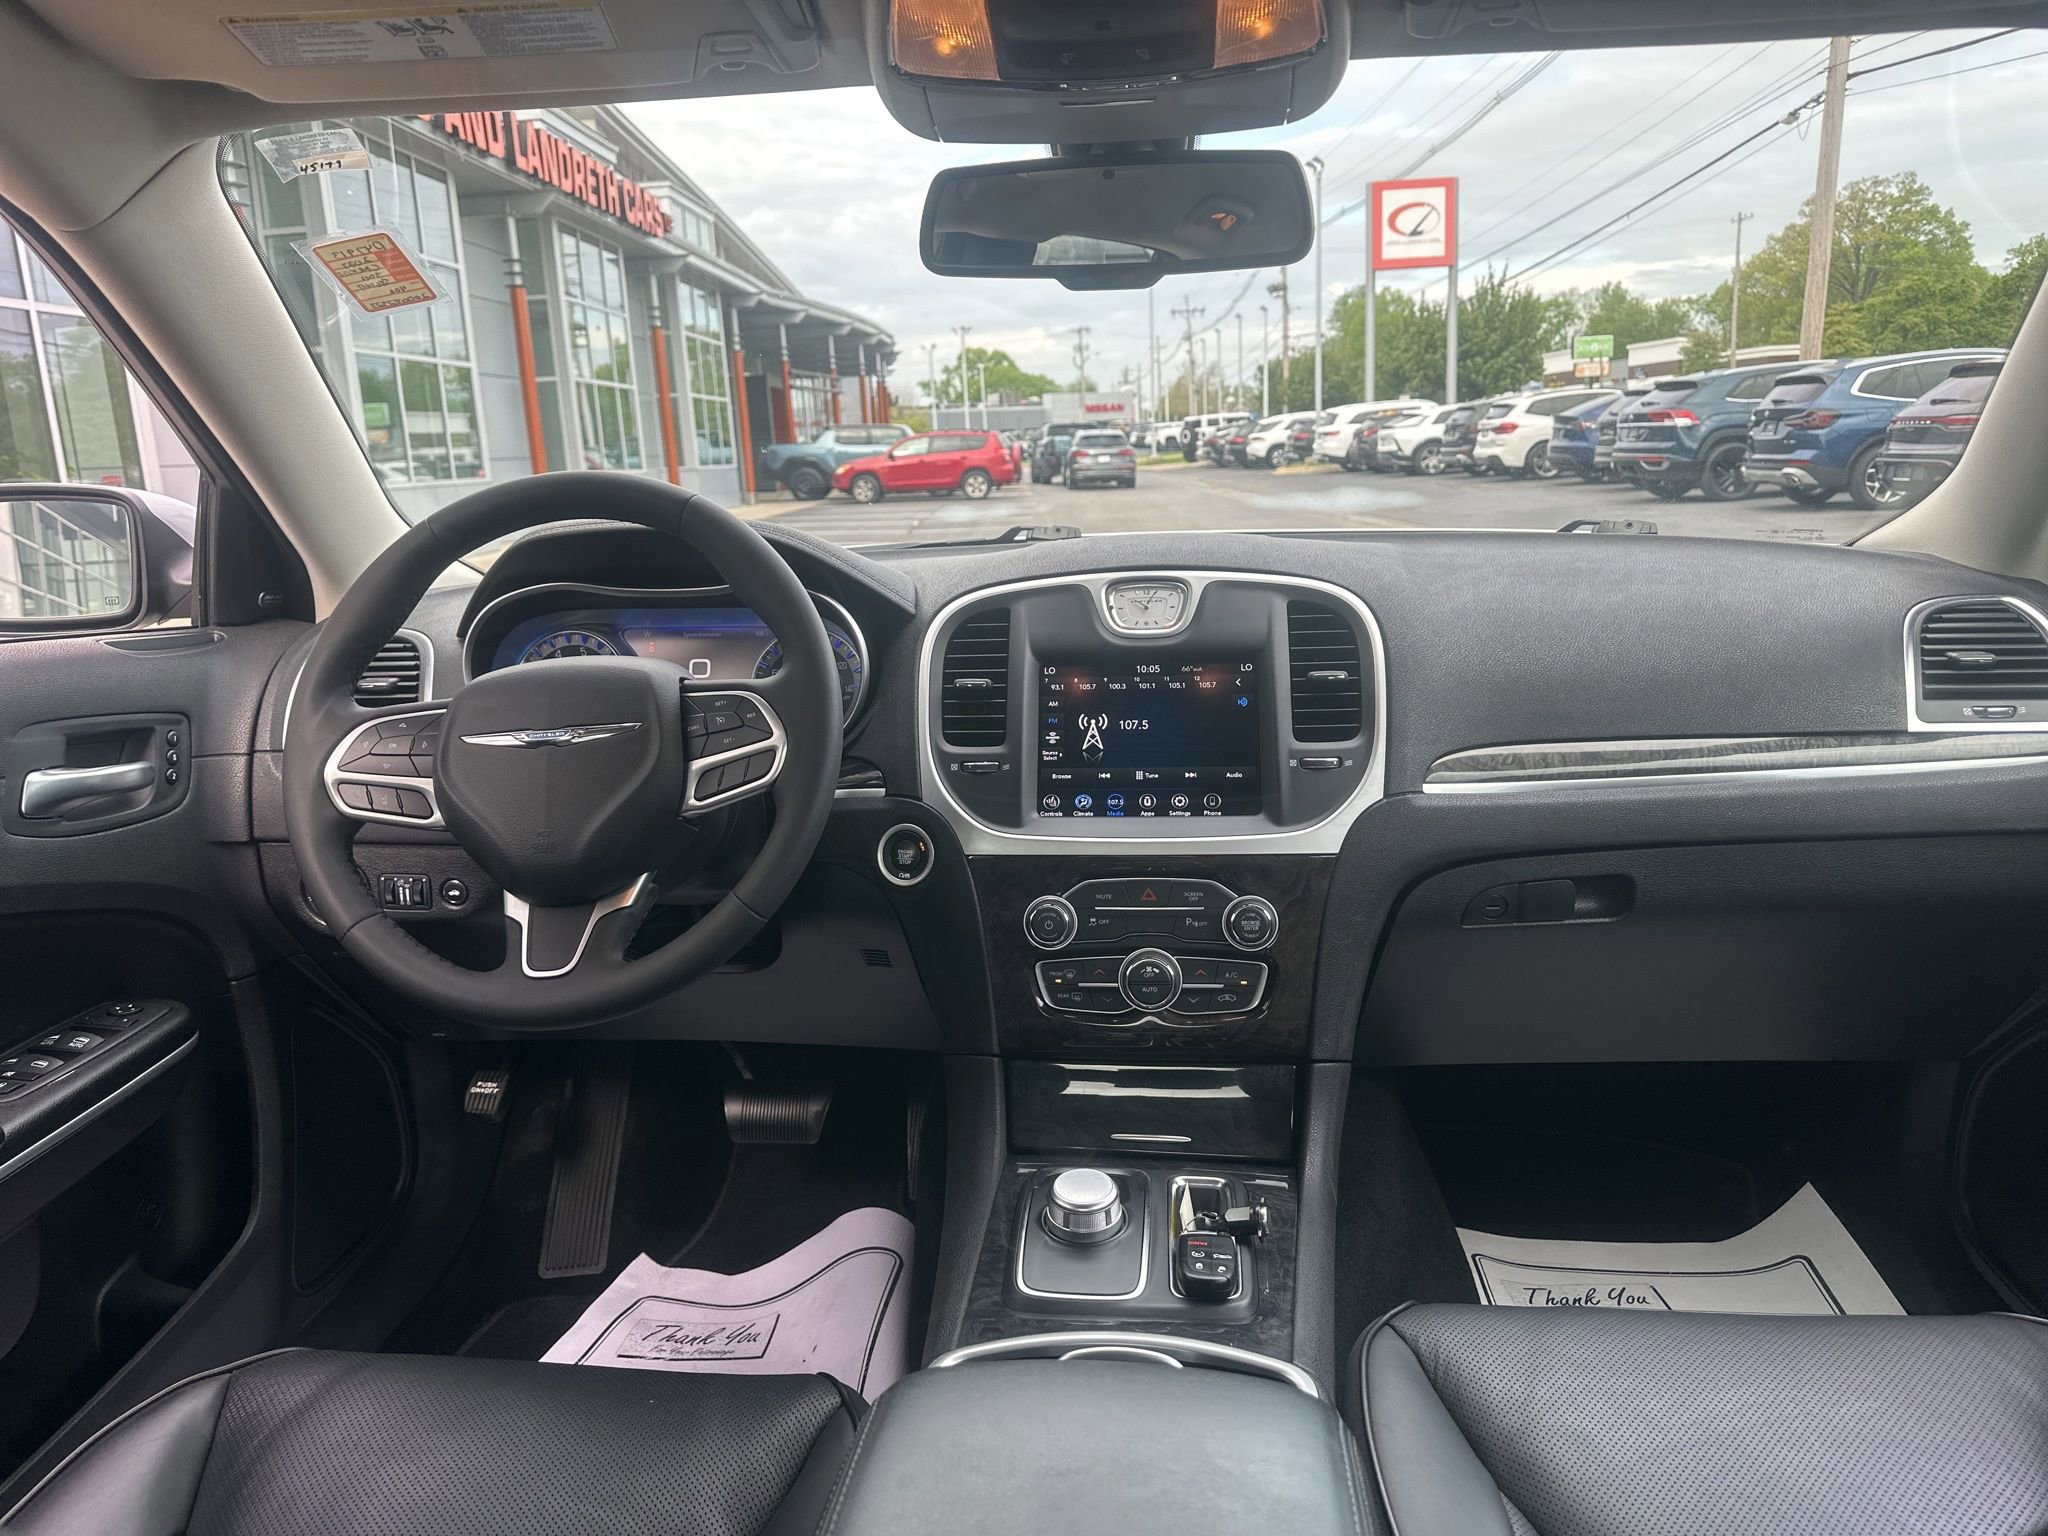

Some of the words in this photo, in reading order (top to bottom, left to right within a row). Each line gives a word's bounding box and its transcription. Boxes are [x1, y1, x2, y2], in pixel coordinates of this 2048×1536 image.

[444, 111, 506, 160] AND
[509, 111, 621, 218] LANDRETH
[622, 178, 666, 238] CARS
[580, 647, 588, 656] 5
[1136, 665, 1161, 673] 10:05
[1240, 663, 1253, 671] LO
[1119, 720, 1149, 730] 107.5
[529, 731, 565, 739] CHRYSLER
[1522, 1287, 1601, 1307] Thank
[1607, 1286, 1651, 1307] You
[641, 1324, 728, 1347] Thank
[725, 1322, 761, 1346] You
